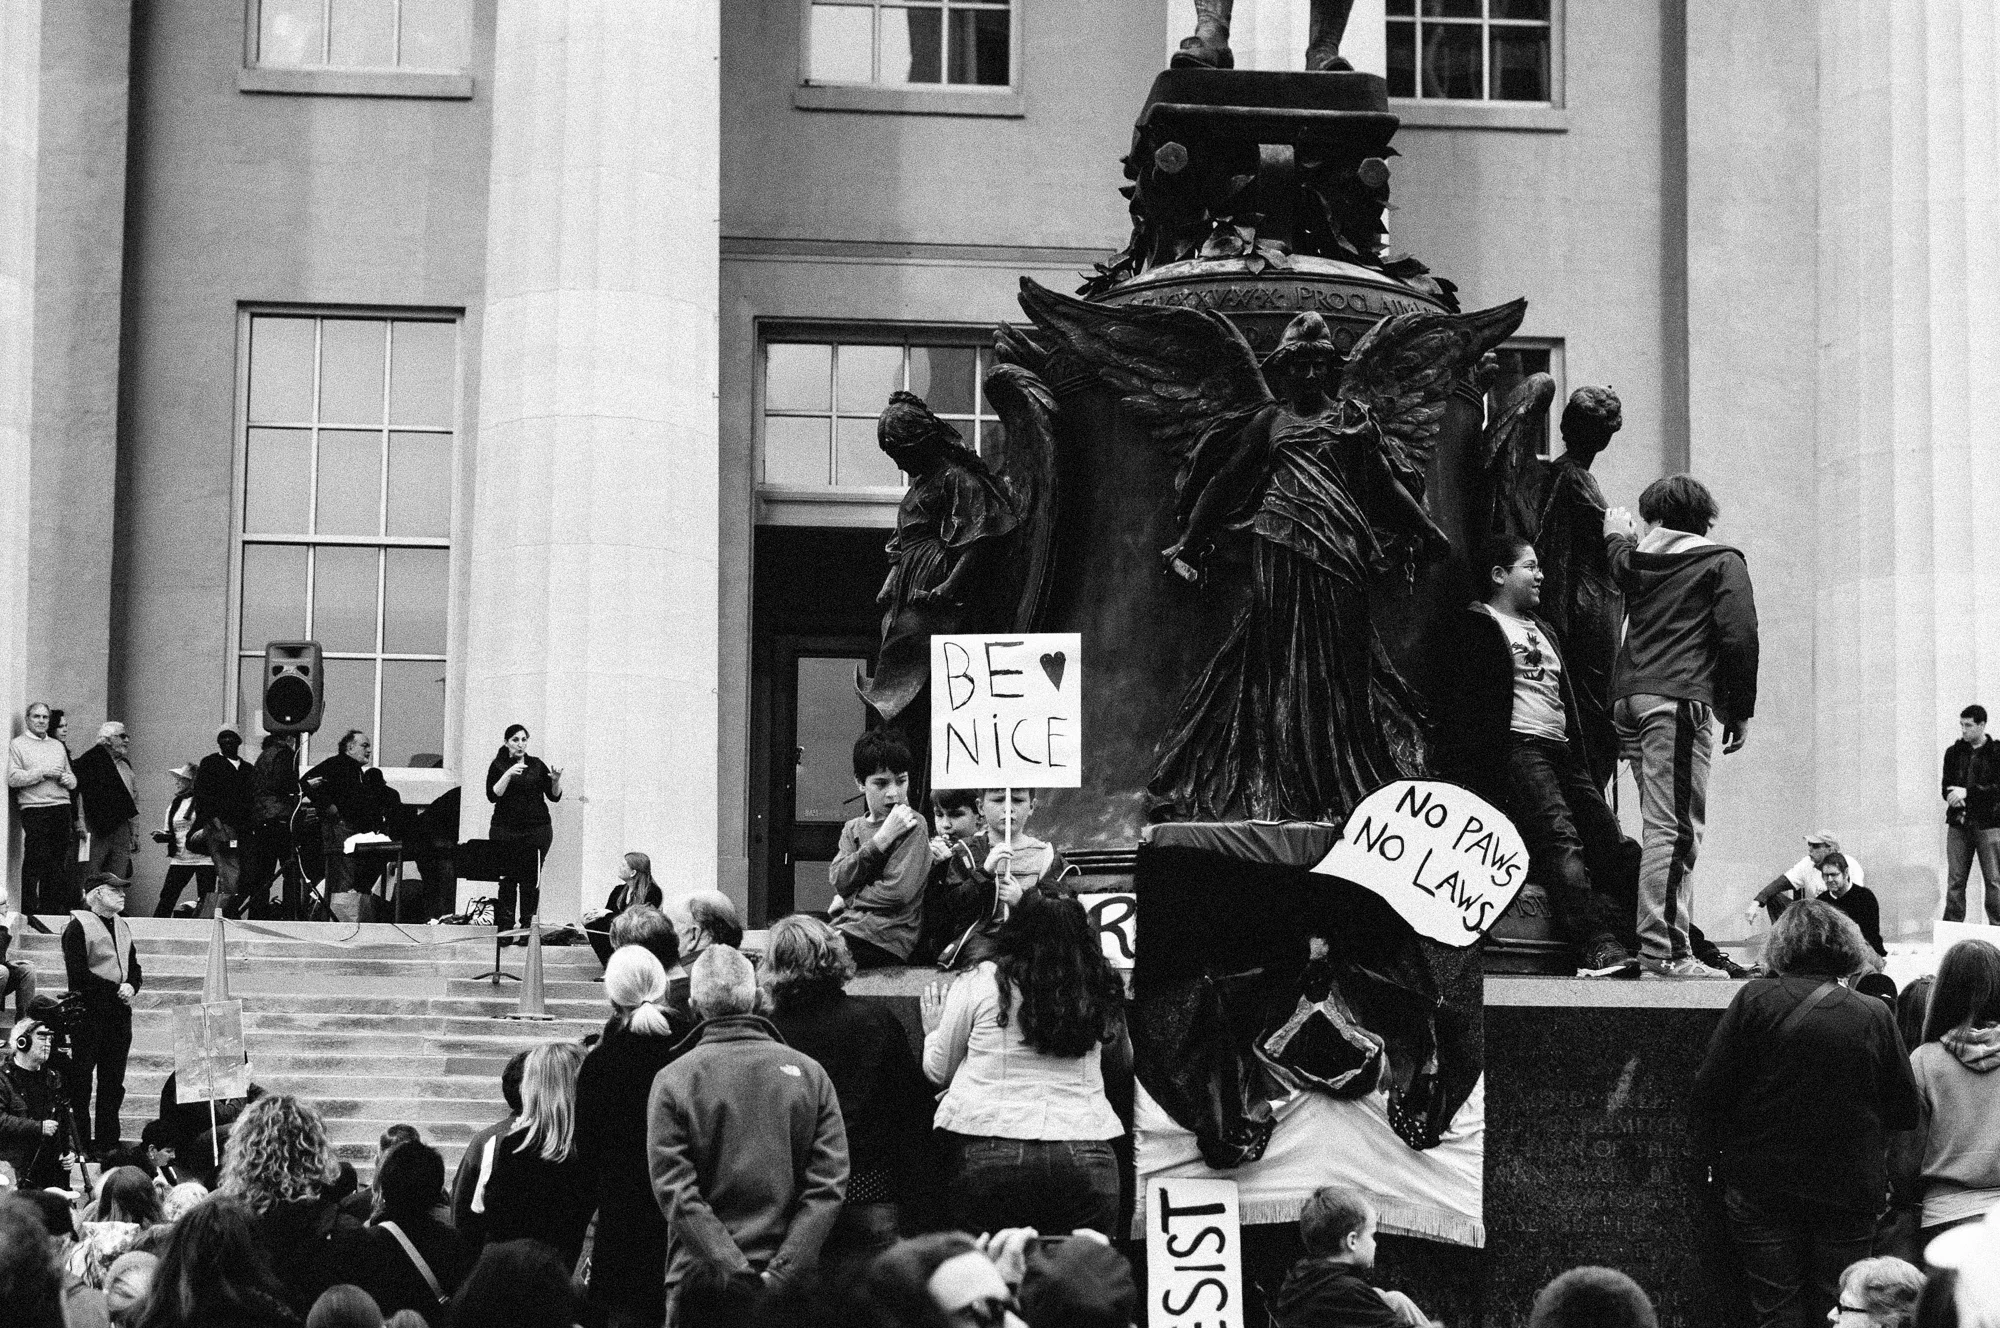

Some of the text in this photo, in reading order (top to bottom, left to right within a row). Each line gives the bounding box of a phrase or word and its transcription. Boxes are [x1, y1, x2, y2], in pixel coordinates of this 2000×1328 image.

[943, 640, 1025, 712] BE
[1353, 816, 1495, 932] NO LAWS
[1395, 784, 1522, 887] NO PAWS
[1158, 1187, 1230, 1328] SIST
